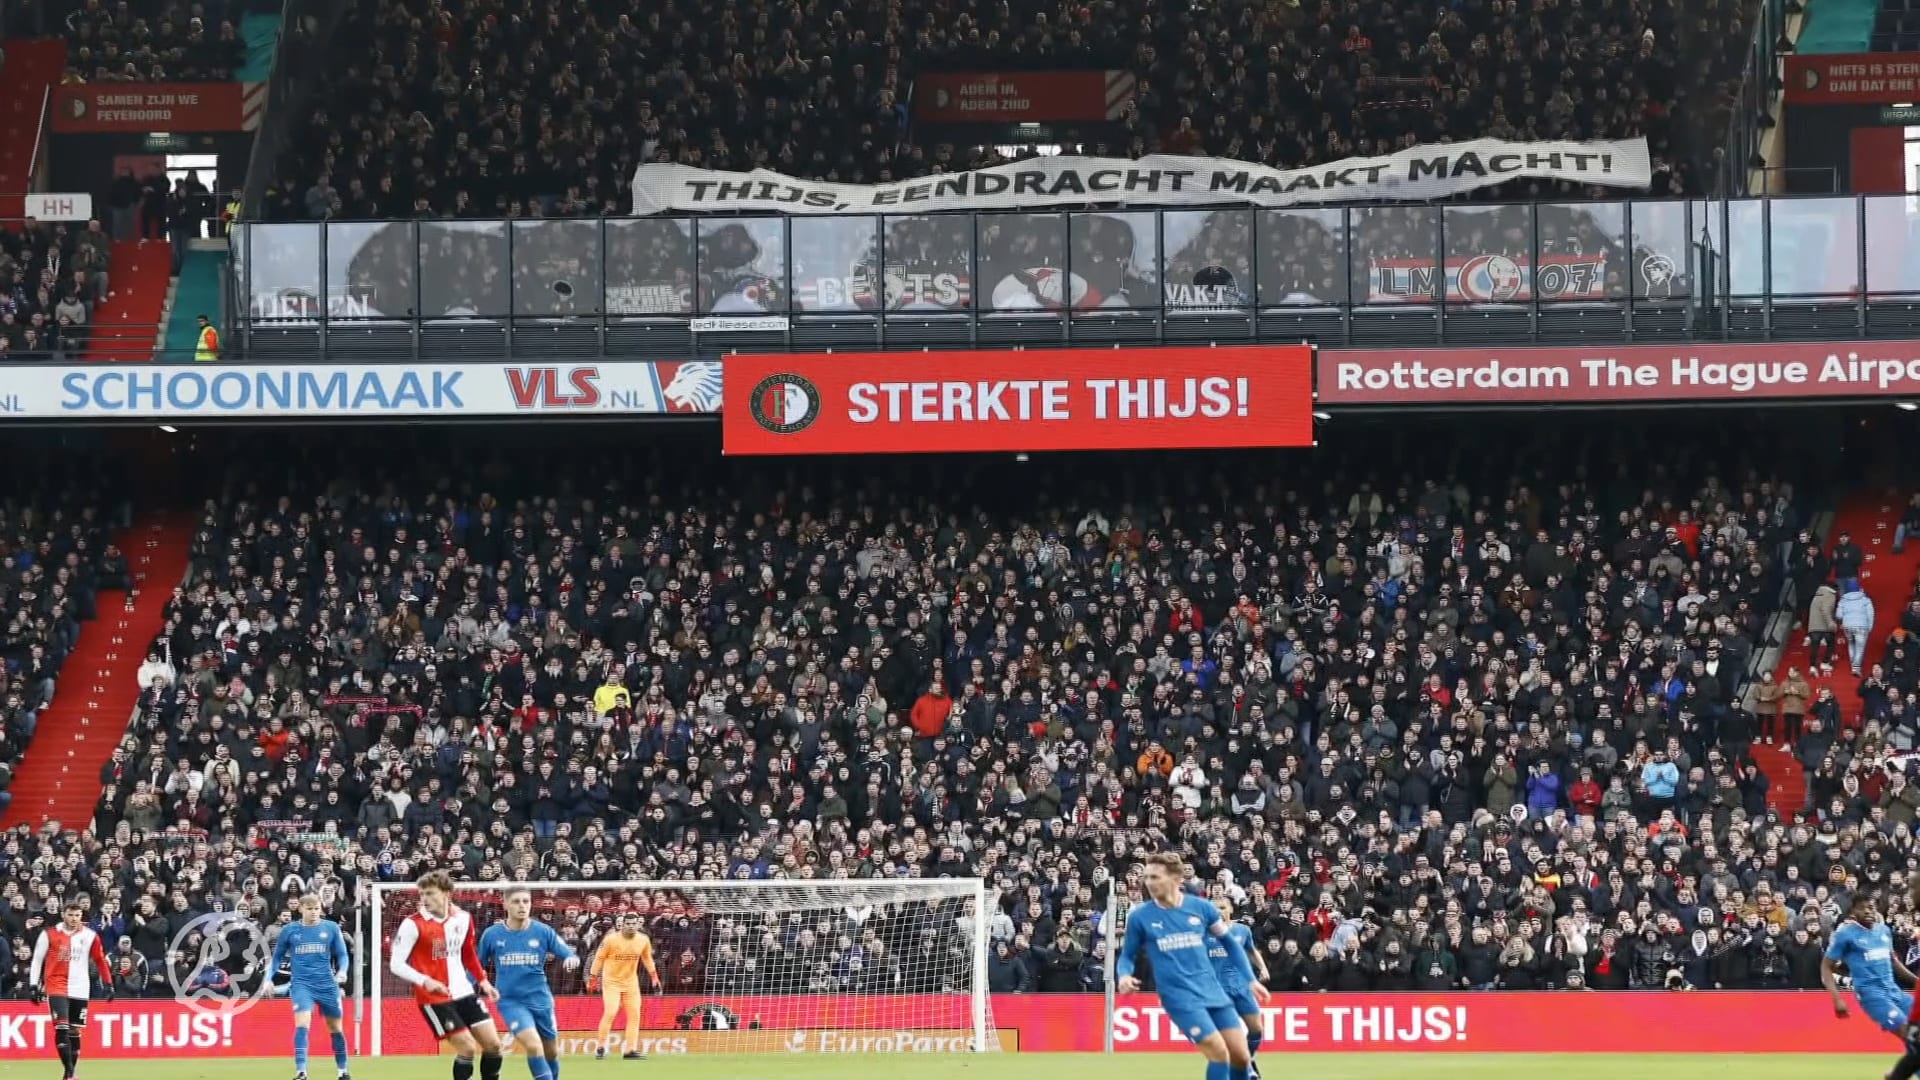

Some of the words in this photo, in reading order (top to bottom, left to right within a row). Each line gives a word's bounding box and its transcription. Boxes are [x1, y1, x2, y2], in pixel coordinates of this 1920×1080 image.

[96, 95, 142, 106] SAMEN
[178, 94, 199, 105] WE
[96, 109, 172, 121] FEYENOORD
[959, 99, 997, 110] ADEM
[685, 180, 851, 211] THIJS,
[871, 169, 1194, 206] EENDRACHT
[1208, 163, 1390, 193] MAAKT
[1408, 151, 1612, 181] MACHT!
[43, 200, 74, 215] HH
[61, 371, 464, 410] SCHOONMAAK
[1336, 359, 1569, 389] Rotterdam
[1580, 358, 1659, 387] The
[1671, 357, 1808, 391] Hague
[846, 380, 1070, 424] STERKTE
[1085, 376, 1249, 420] THIJS!
[0, 1013, 52, 1048] KT
[94, 1013, 233, 1047] THIJS!
[1323, 1005, 1468, 1041] THIJS!
[819, 1031, 976, 1053] EuroParcs
